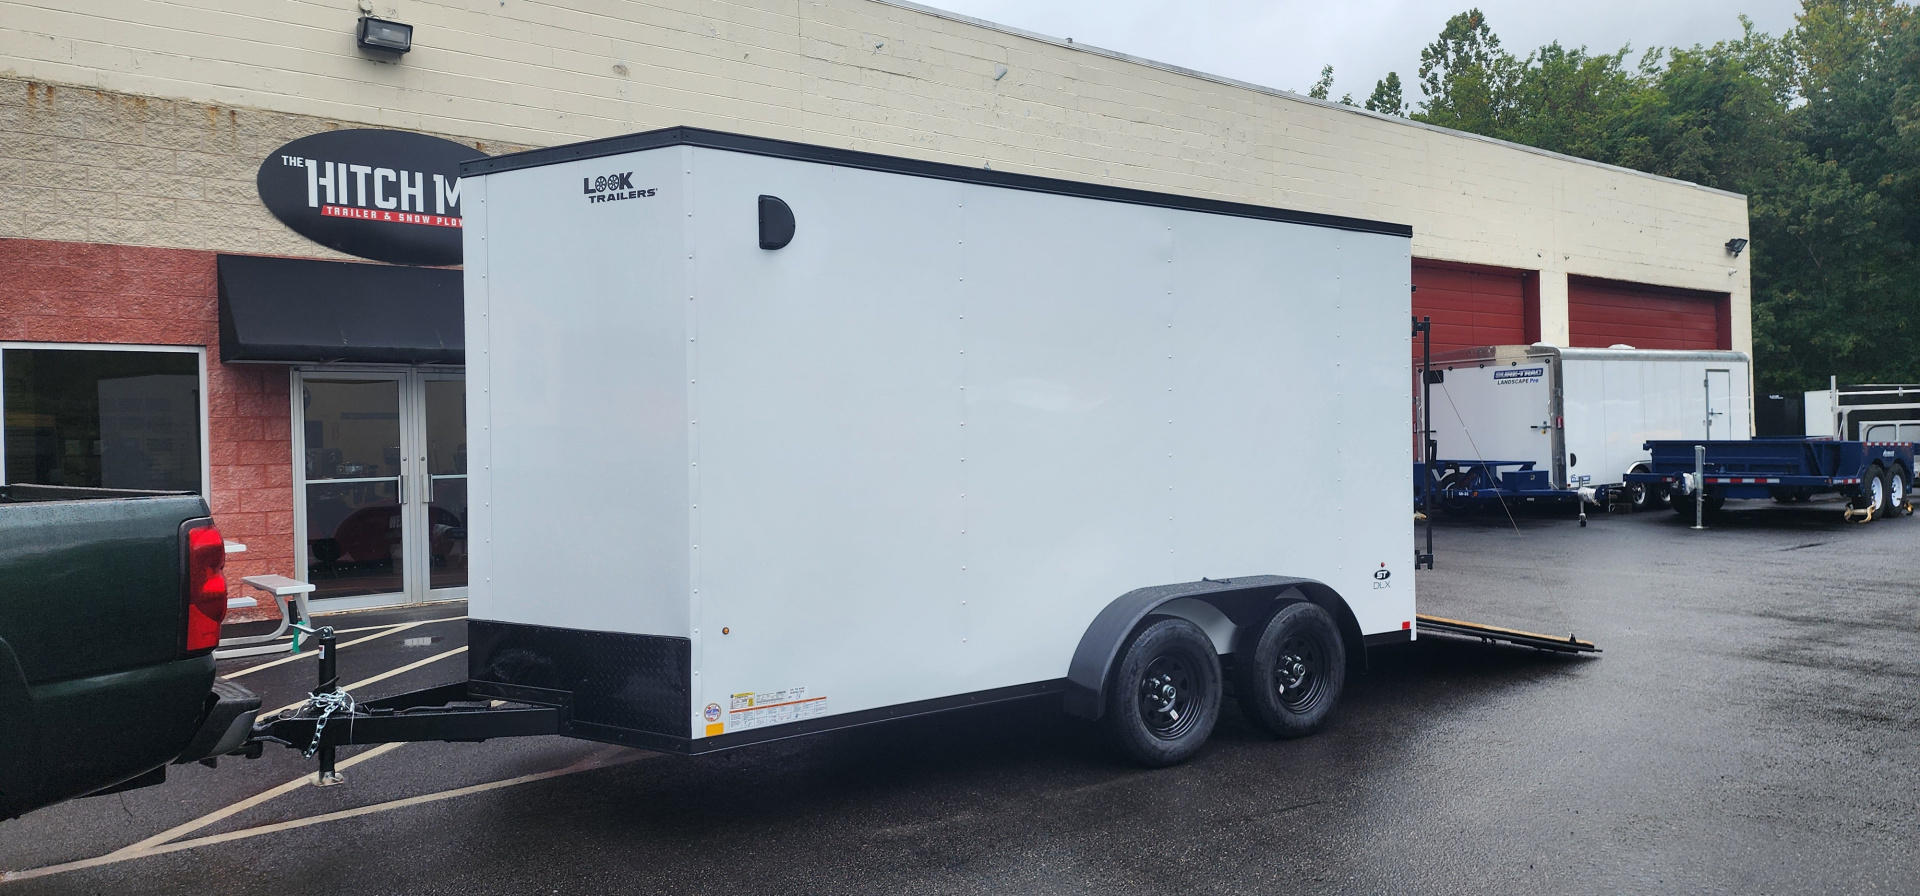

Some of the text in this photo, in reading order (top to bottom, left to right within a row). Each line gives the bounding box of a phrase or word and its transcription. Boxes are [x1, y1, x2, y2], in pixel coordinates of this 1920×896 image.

[281, 155, 304, 167] THE
[305, 159, 424, 213] HITCH
[584, 171, 634, 194] LOOK
[589, 188, 656, 203] TRAILERS
[326, 206, 377, 219] TRAILER
[384, 212, 391, 220] &
[399, 213, 430, 224] SNOW
[1495, 369, 1542, 379] SURE-TRAC
[1376, 571, 1388, 579] ST
[1373, 581, 1391, 589] DLX
